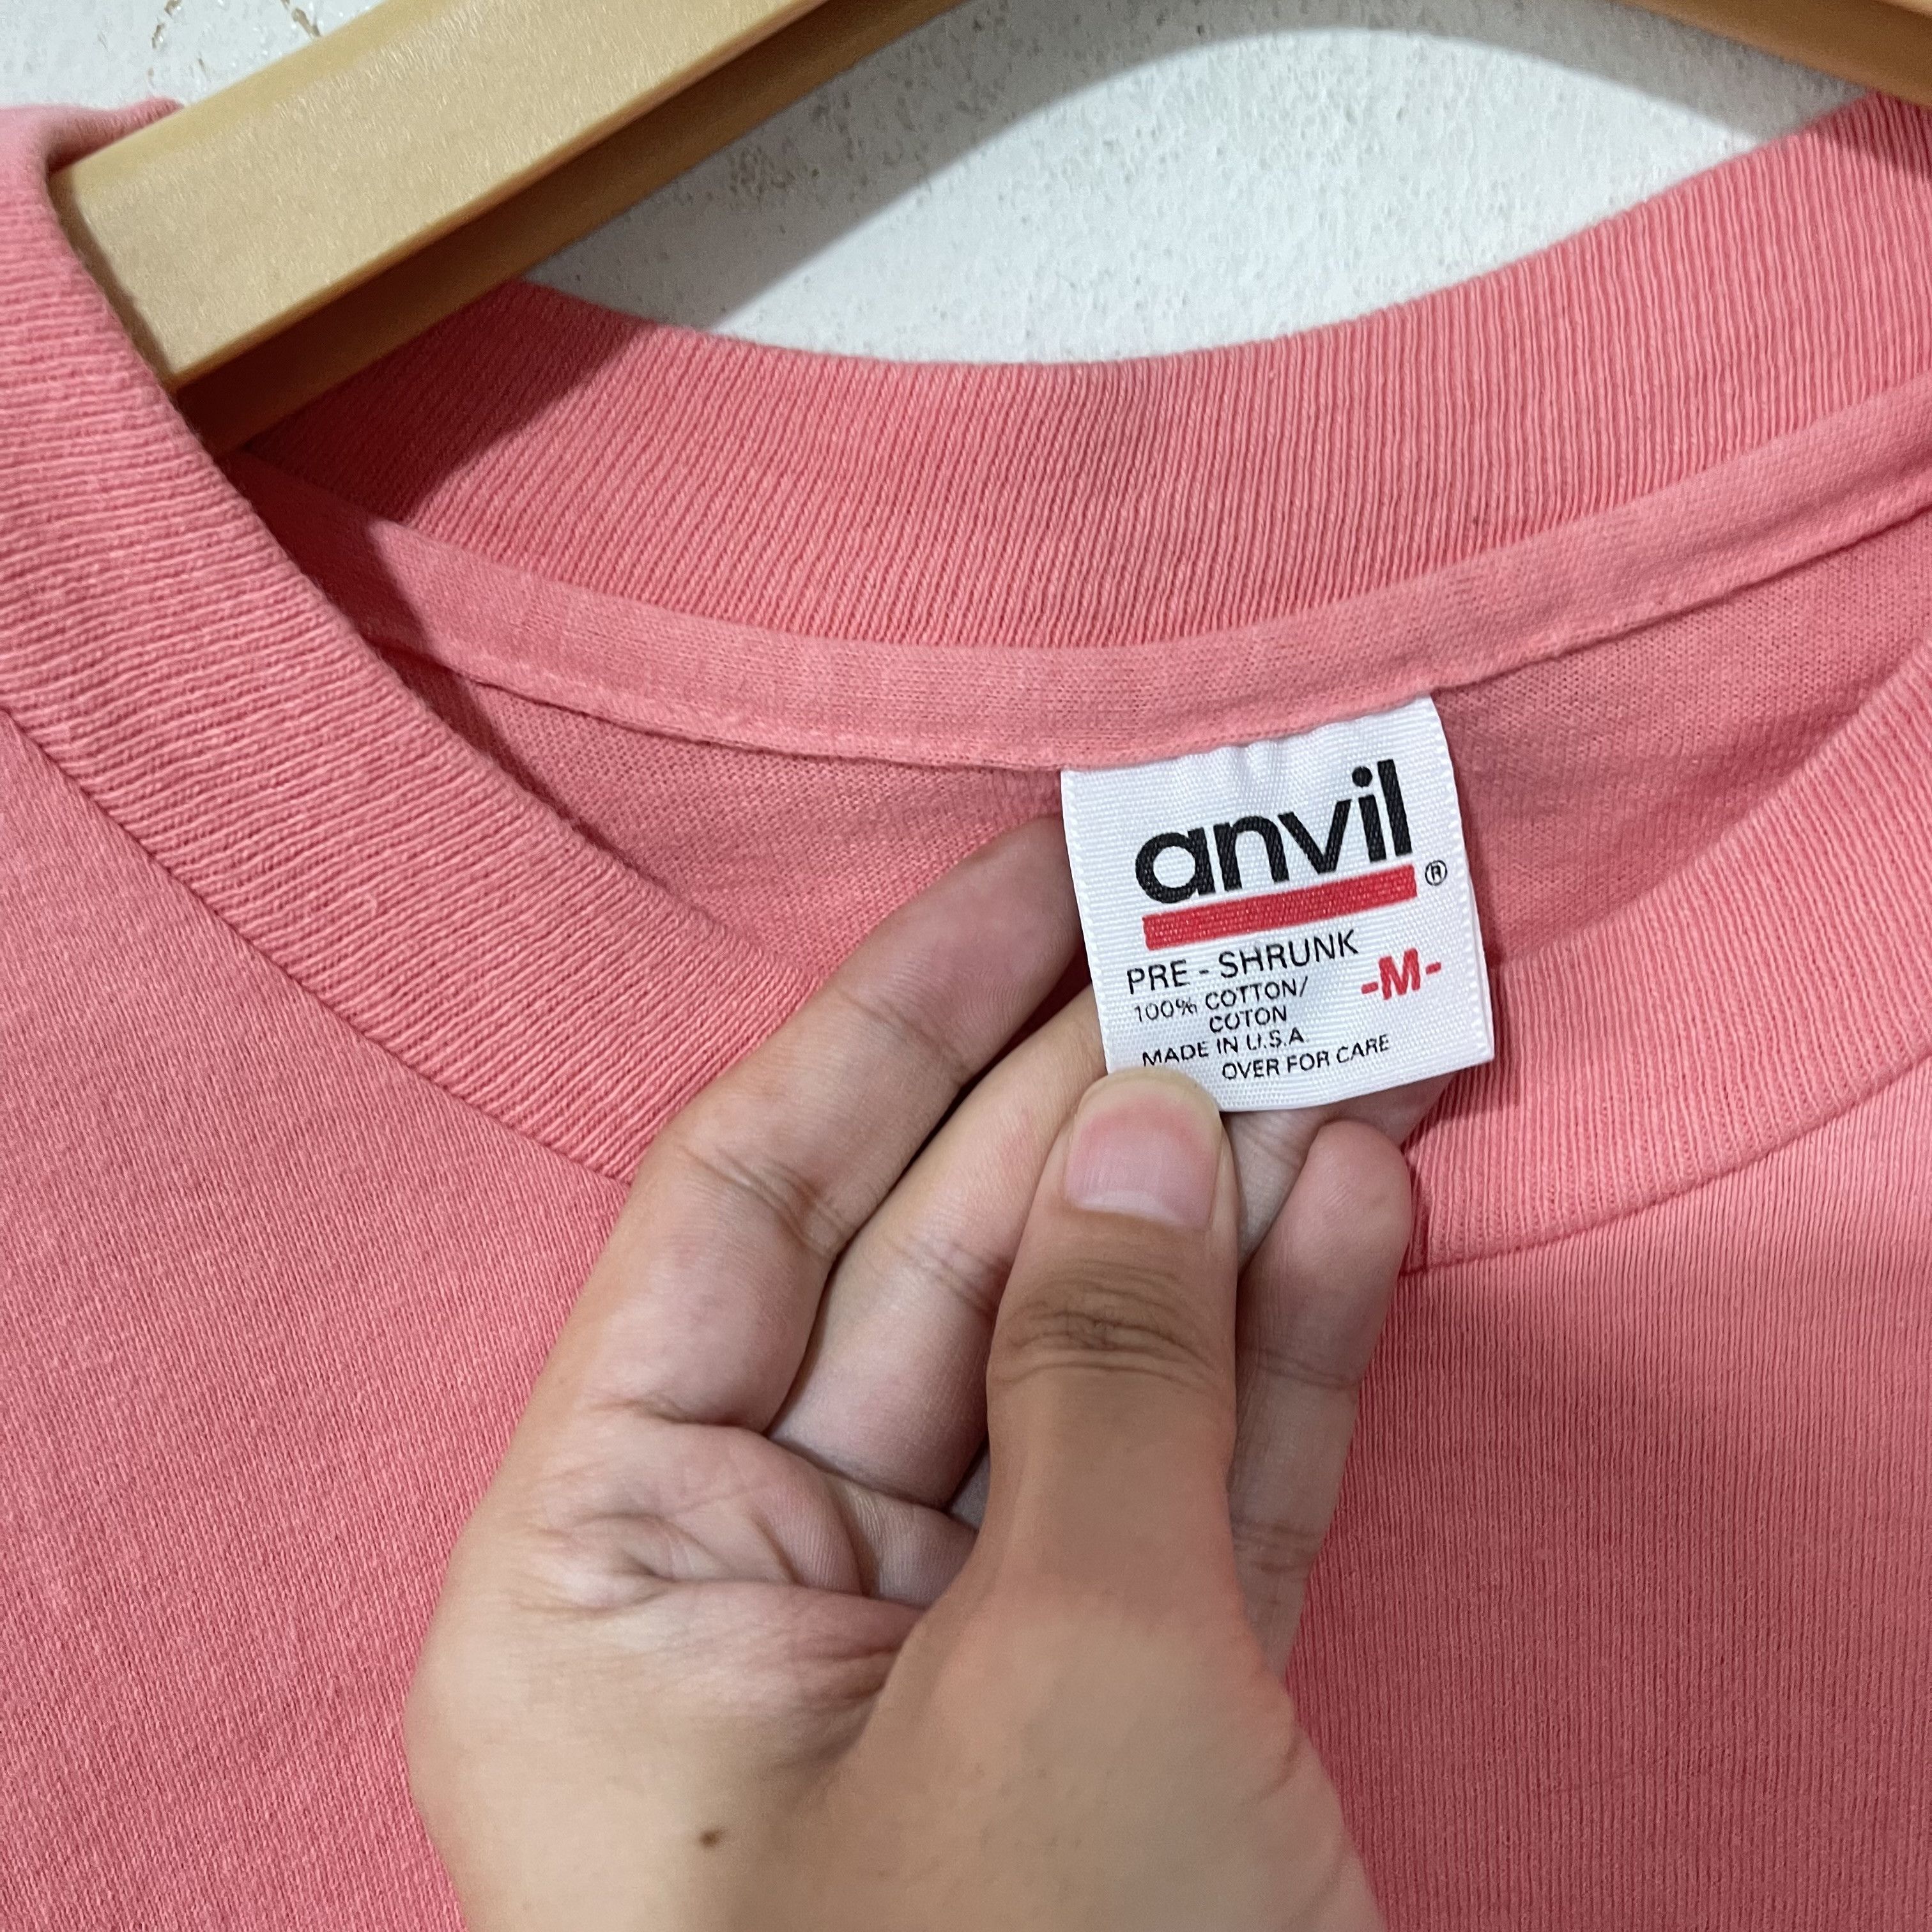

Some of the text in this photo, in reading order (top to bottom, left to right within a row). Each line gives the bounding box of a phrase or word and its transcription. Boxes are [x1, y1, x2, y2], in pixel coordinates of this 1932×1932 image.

[1135, 759, 1413, 904] anvil
[1126, 959, 1191, 995] PRE
[1218, 929, 1359, 979] SHRUNK
[1135, 976, 1308, 1023] 100% COTTON/
[1209, 1006, 1287, 1034] COTON
[1142, 1041, 1209, 1066] MADE
[1216, 1036, 1238, 1054] IN
[1222, 1034, 1390, 1080] OVER FOR CARE
